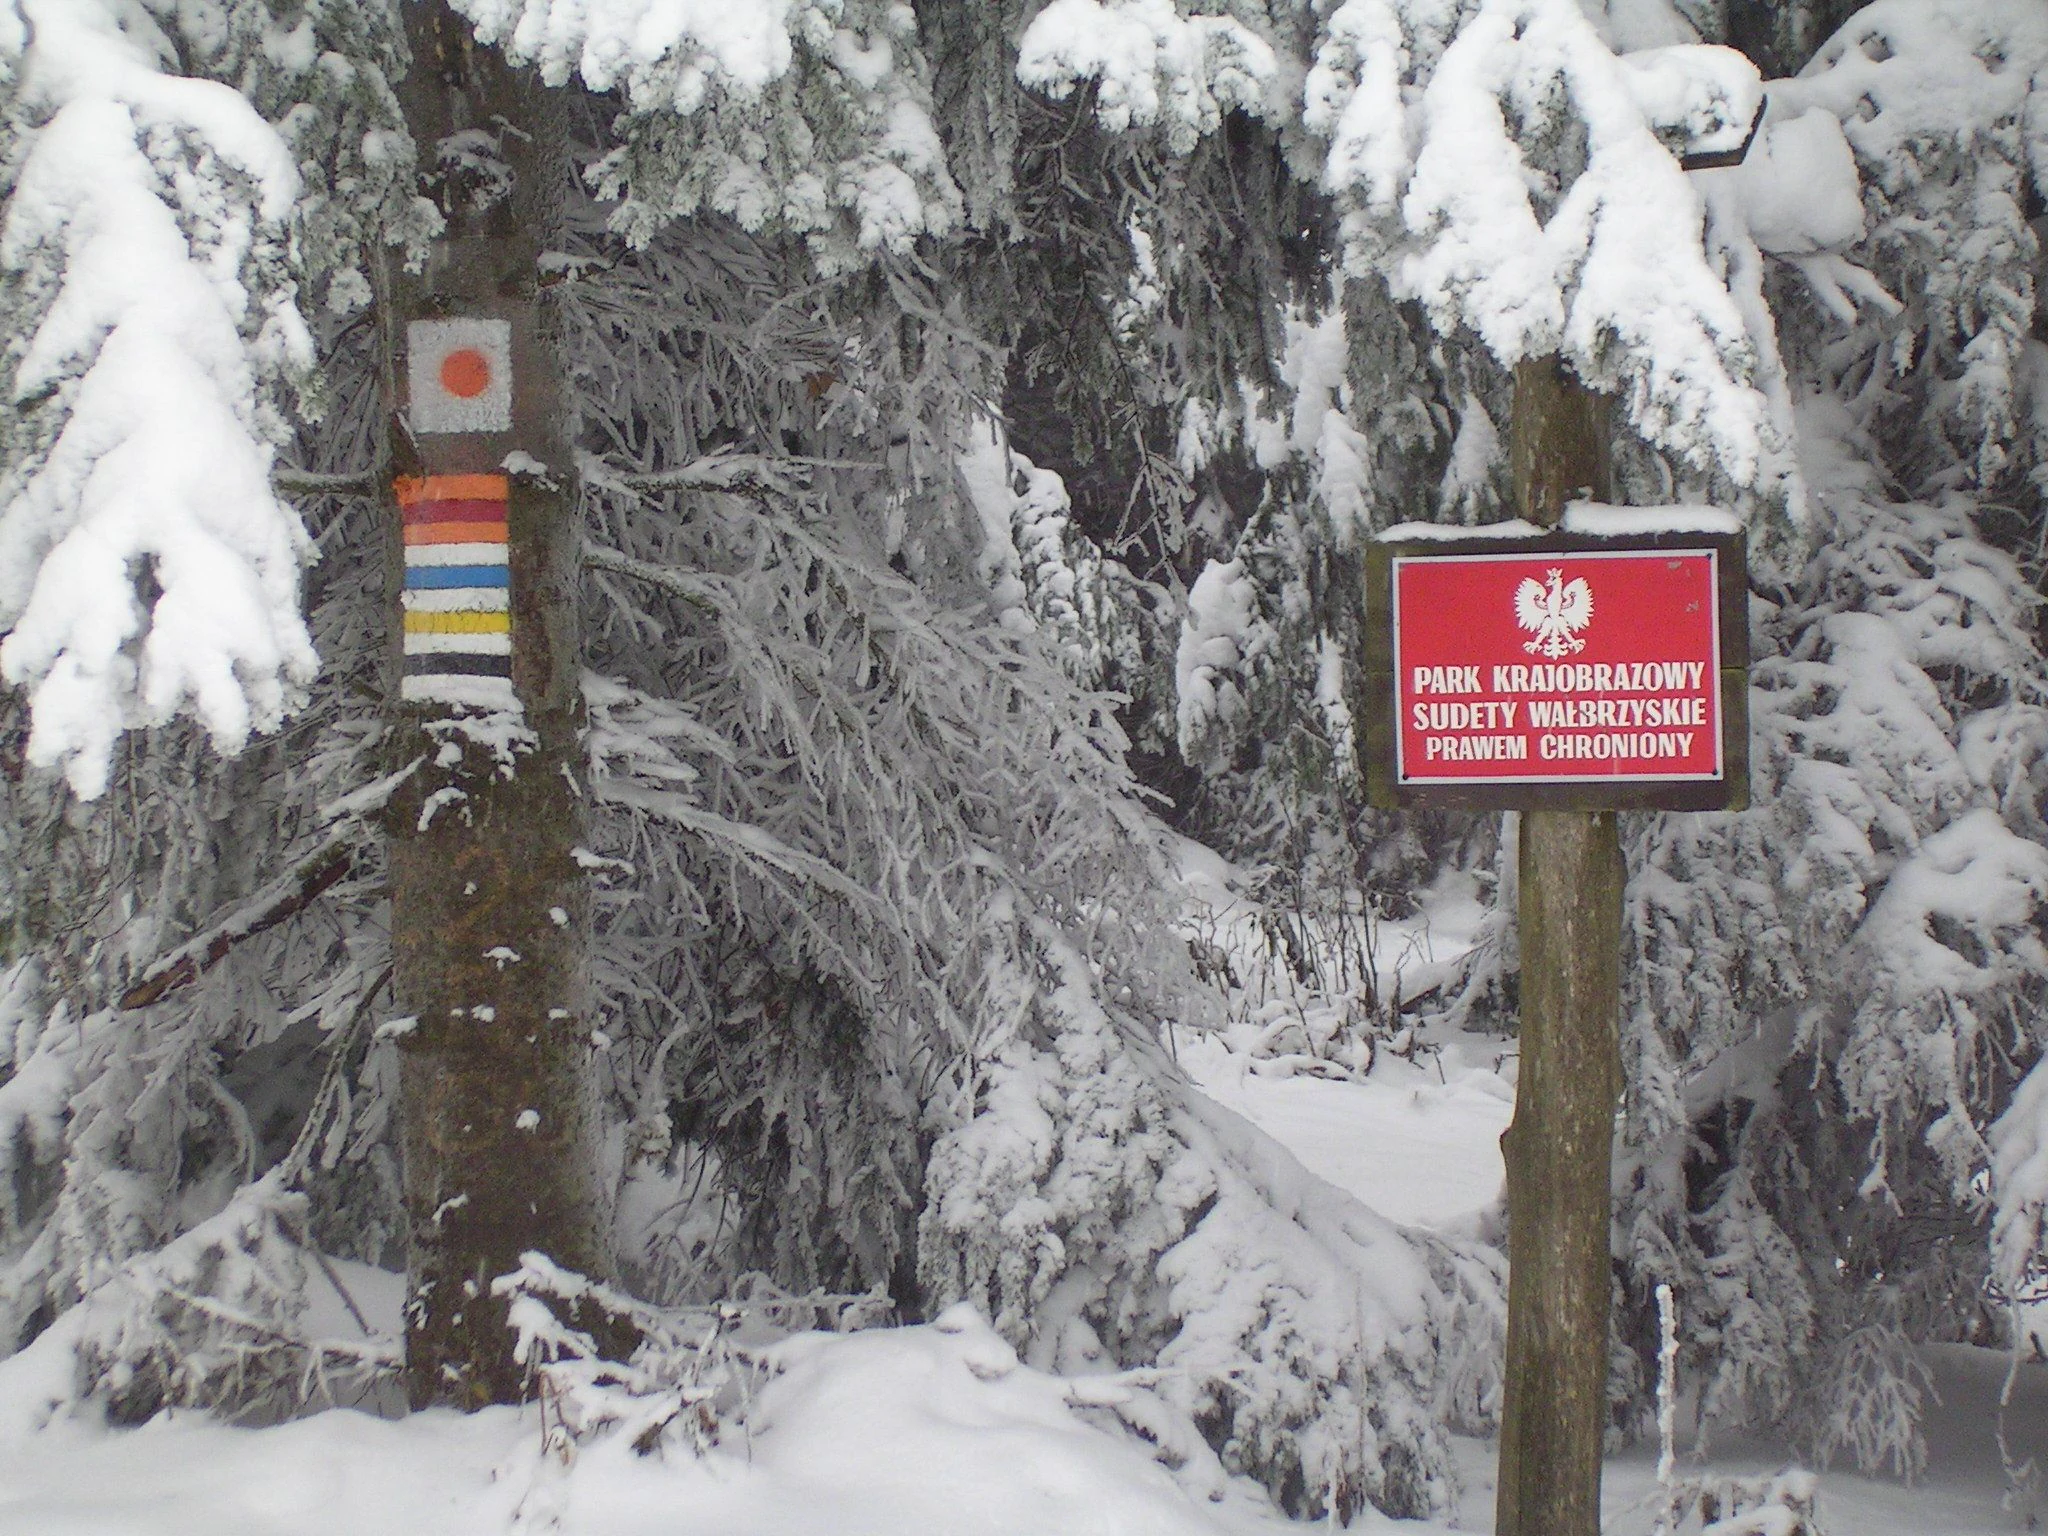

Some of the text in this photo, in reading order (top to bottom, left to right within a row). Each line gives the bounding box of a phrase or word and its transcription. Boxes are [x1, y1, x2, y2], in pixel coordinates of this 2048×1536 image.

[1414, 661, 1705, 694] PARK KRAJOBRAZOWY
[1413, 697, 1706, 731] SUDETY WAŁBRZYSKIE
[1426, 732, 1694, 761] PRAWEM CHRONIONY
